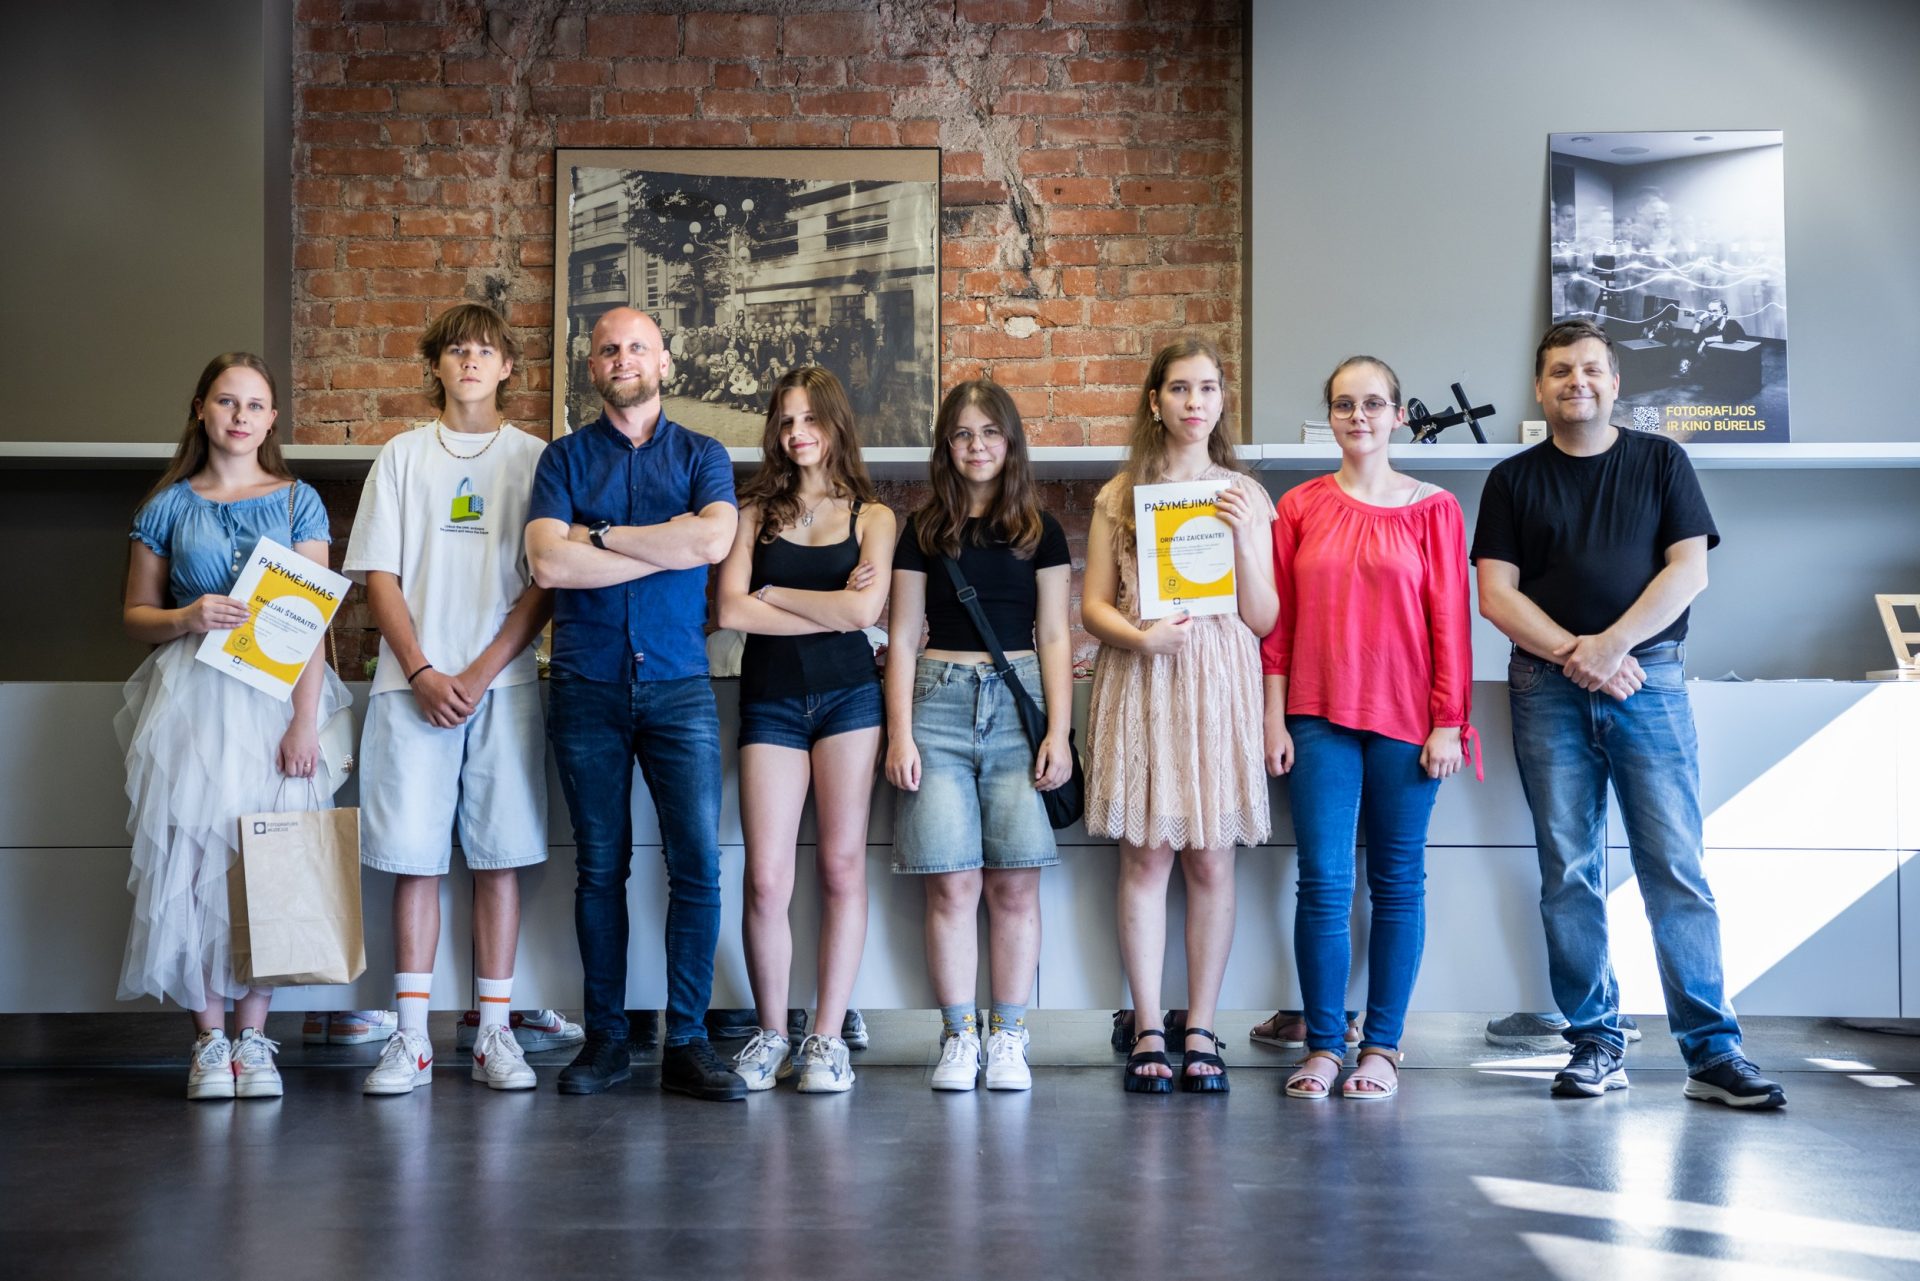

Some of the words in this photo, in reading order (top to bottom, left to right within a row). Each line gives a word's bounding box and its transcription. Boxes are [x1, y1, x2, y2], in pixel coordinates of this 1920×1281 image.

[1666, 406, 1756, 416] FOTOGRAFIJOS
[1666, 421, 1678, 432] IR
[1682, 421, 1711, 431] KINO
[1714, 418, 1766, 431] BŪRELIS
[1144, 497, 1222, 512] PAŽYMĖJIMAS
[258, 557, 334, 601] PAŽYMĖJIMAS
[256, 596, 284, 614] EMILIJAI
[284, 609, 318, 630] ŠTARAITEI
